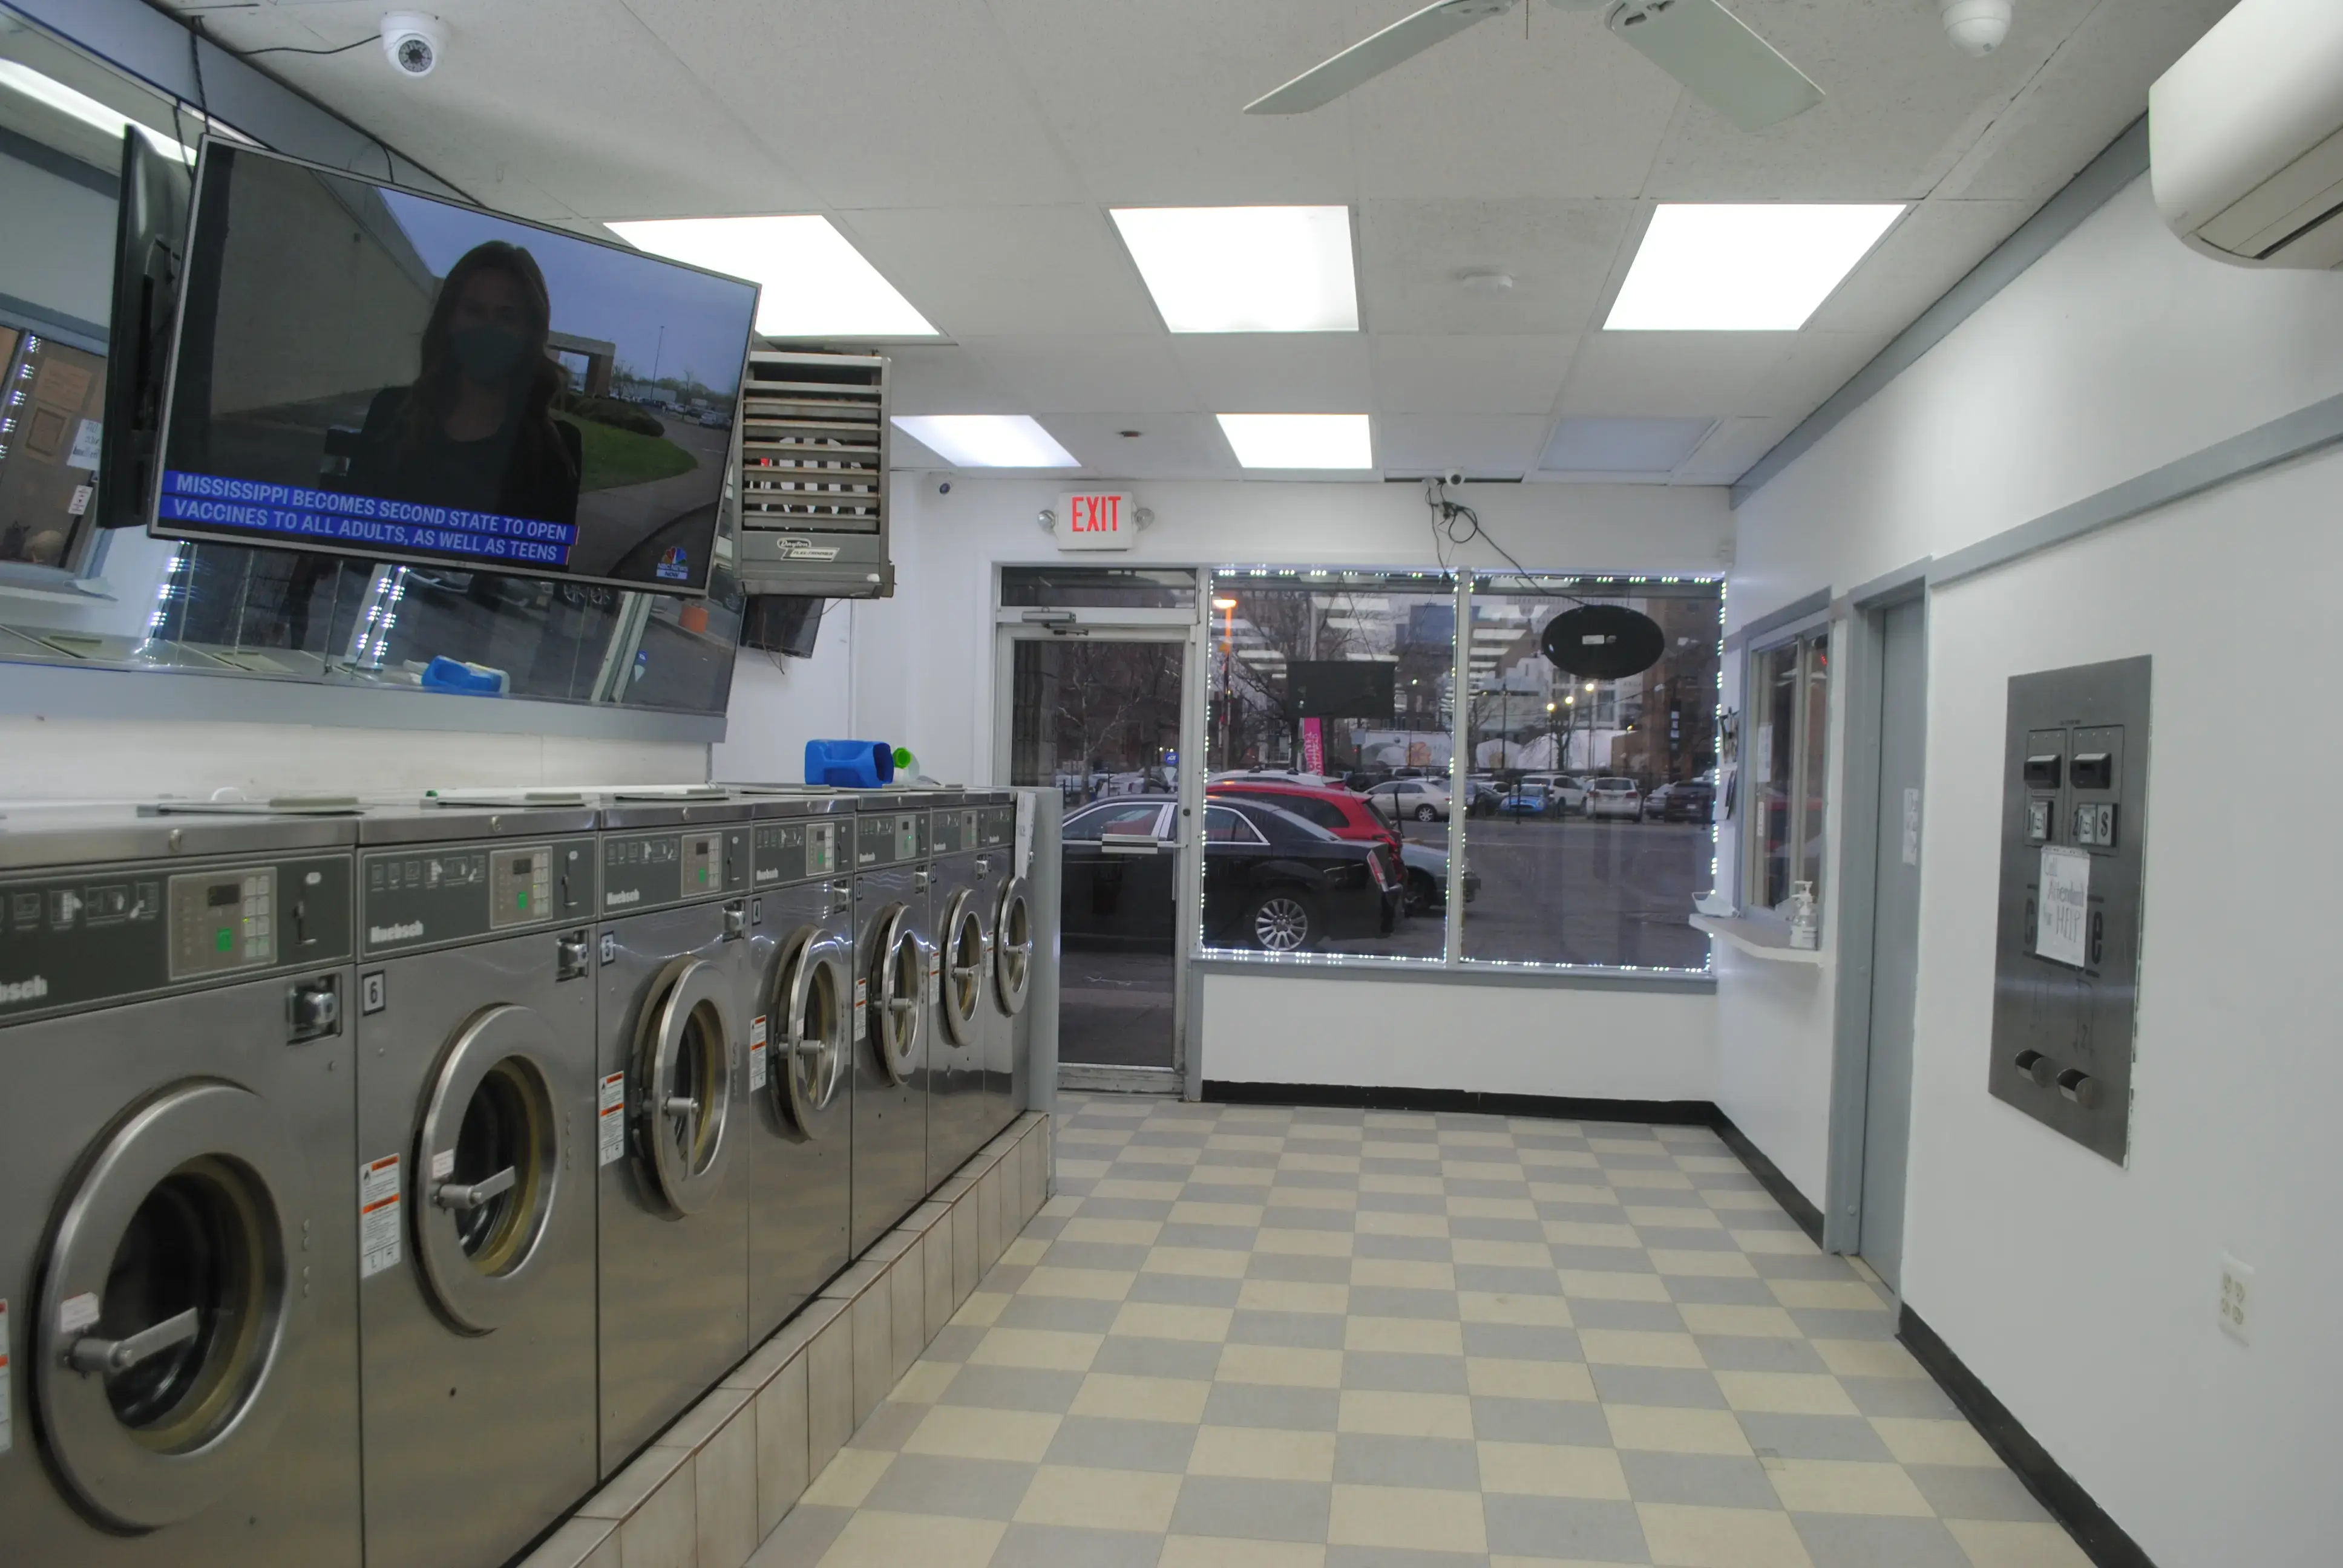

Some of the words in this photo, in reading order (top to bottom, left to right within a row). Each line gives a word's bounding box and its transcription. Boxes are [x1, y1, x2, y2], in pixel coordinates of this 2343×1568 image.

[174, 499, 268, 526] VACCINES
[274, 511, 297, 529] TO
[301, 515, 334, 534] ALL
[338, 520, 409, 545] ADULTS,
[413, 529, 435, 546] AS
[439, 531, 480, 552] WELL
[485, 538, 506, 555] AS
[510, 540, 557, 561] TEENS
[176, 474, 289, 505] MISSISSIPPI
[292, 489, 376, 515] BECOMES
[379, 501, 445, 524] SECOND
[450, 511, 499, 532] STATE
[503, 518, 524, 535] TO
[527, 522, 567, 541] OPEN
[1072, 495, 1121, 532] EXIT
[370, 981, 378, 1002] 6
